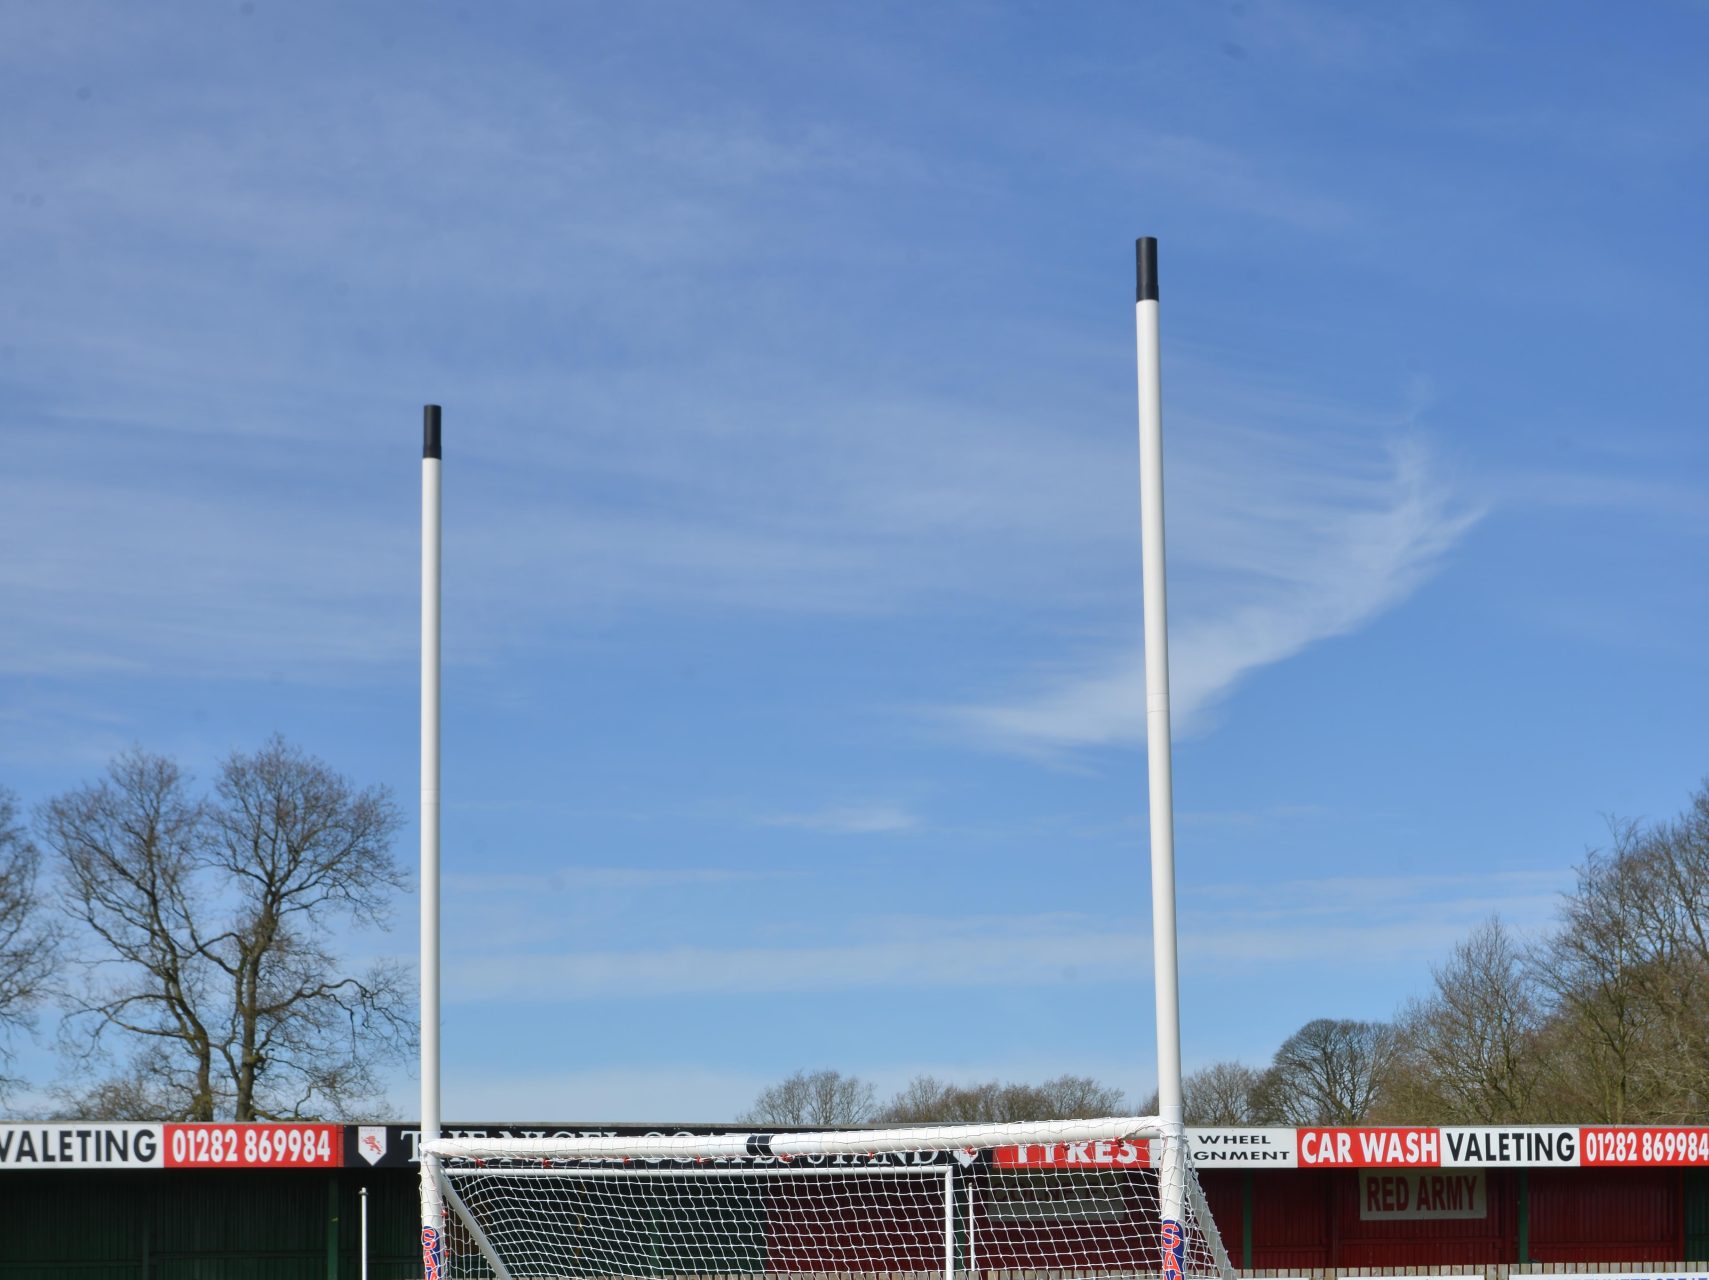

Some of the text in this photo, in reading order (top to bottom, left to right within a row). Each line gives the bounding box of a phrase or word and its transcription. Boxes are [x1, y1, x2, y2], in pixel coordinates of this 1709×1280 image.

[0, 1129, 157, 1162] VALETING
[172, 1128, 331, 1163] 01282 869984
[1198, 1135, 1271, 1145] WHEEL
[1301, 1132, 1438, 1164] CAR WASH
[1446, 1132, 1576, 1162] VALETING
[1585, 1131, 1709, 1162] 01282 869984
[1366, 1175, 1478, 1212] RED ARMY
